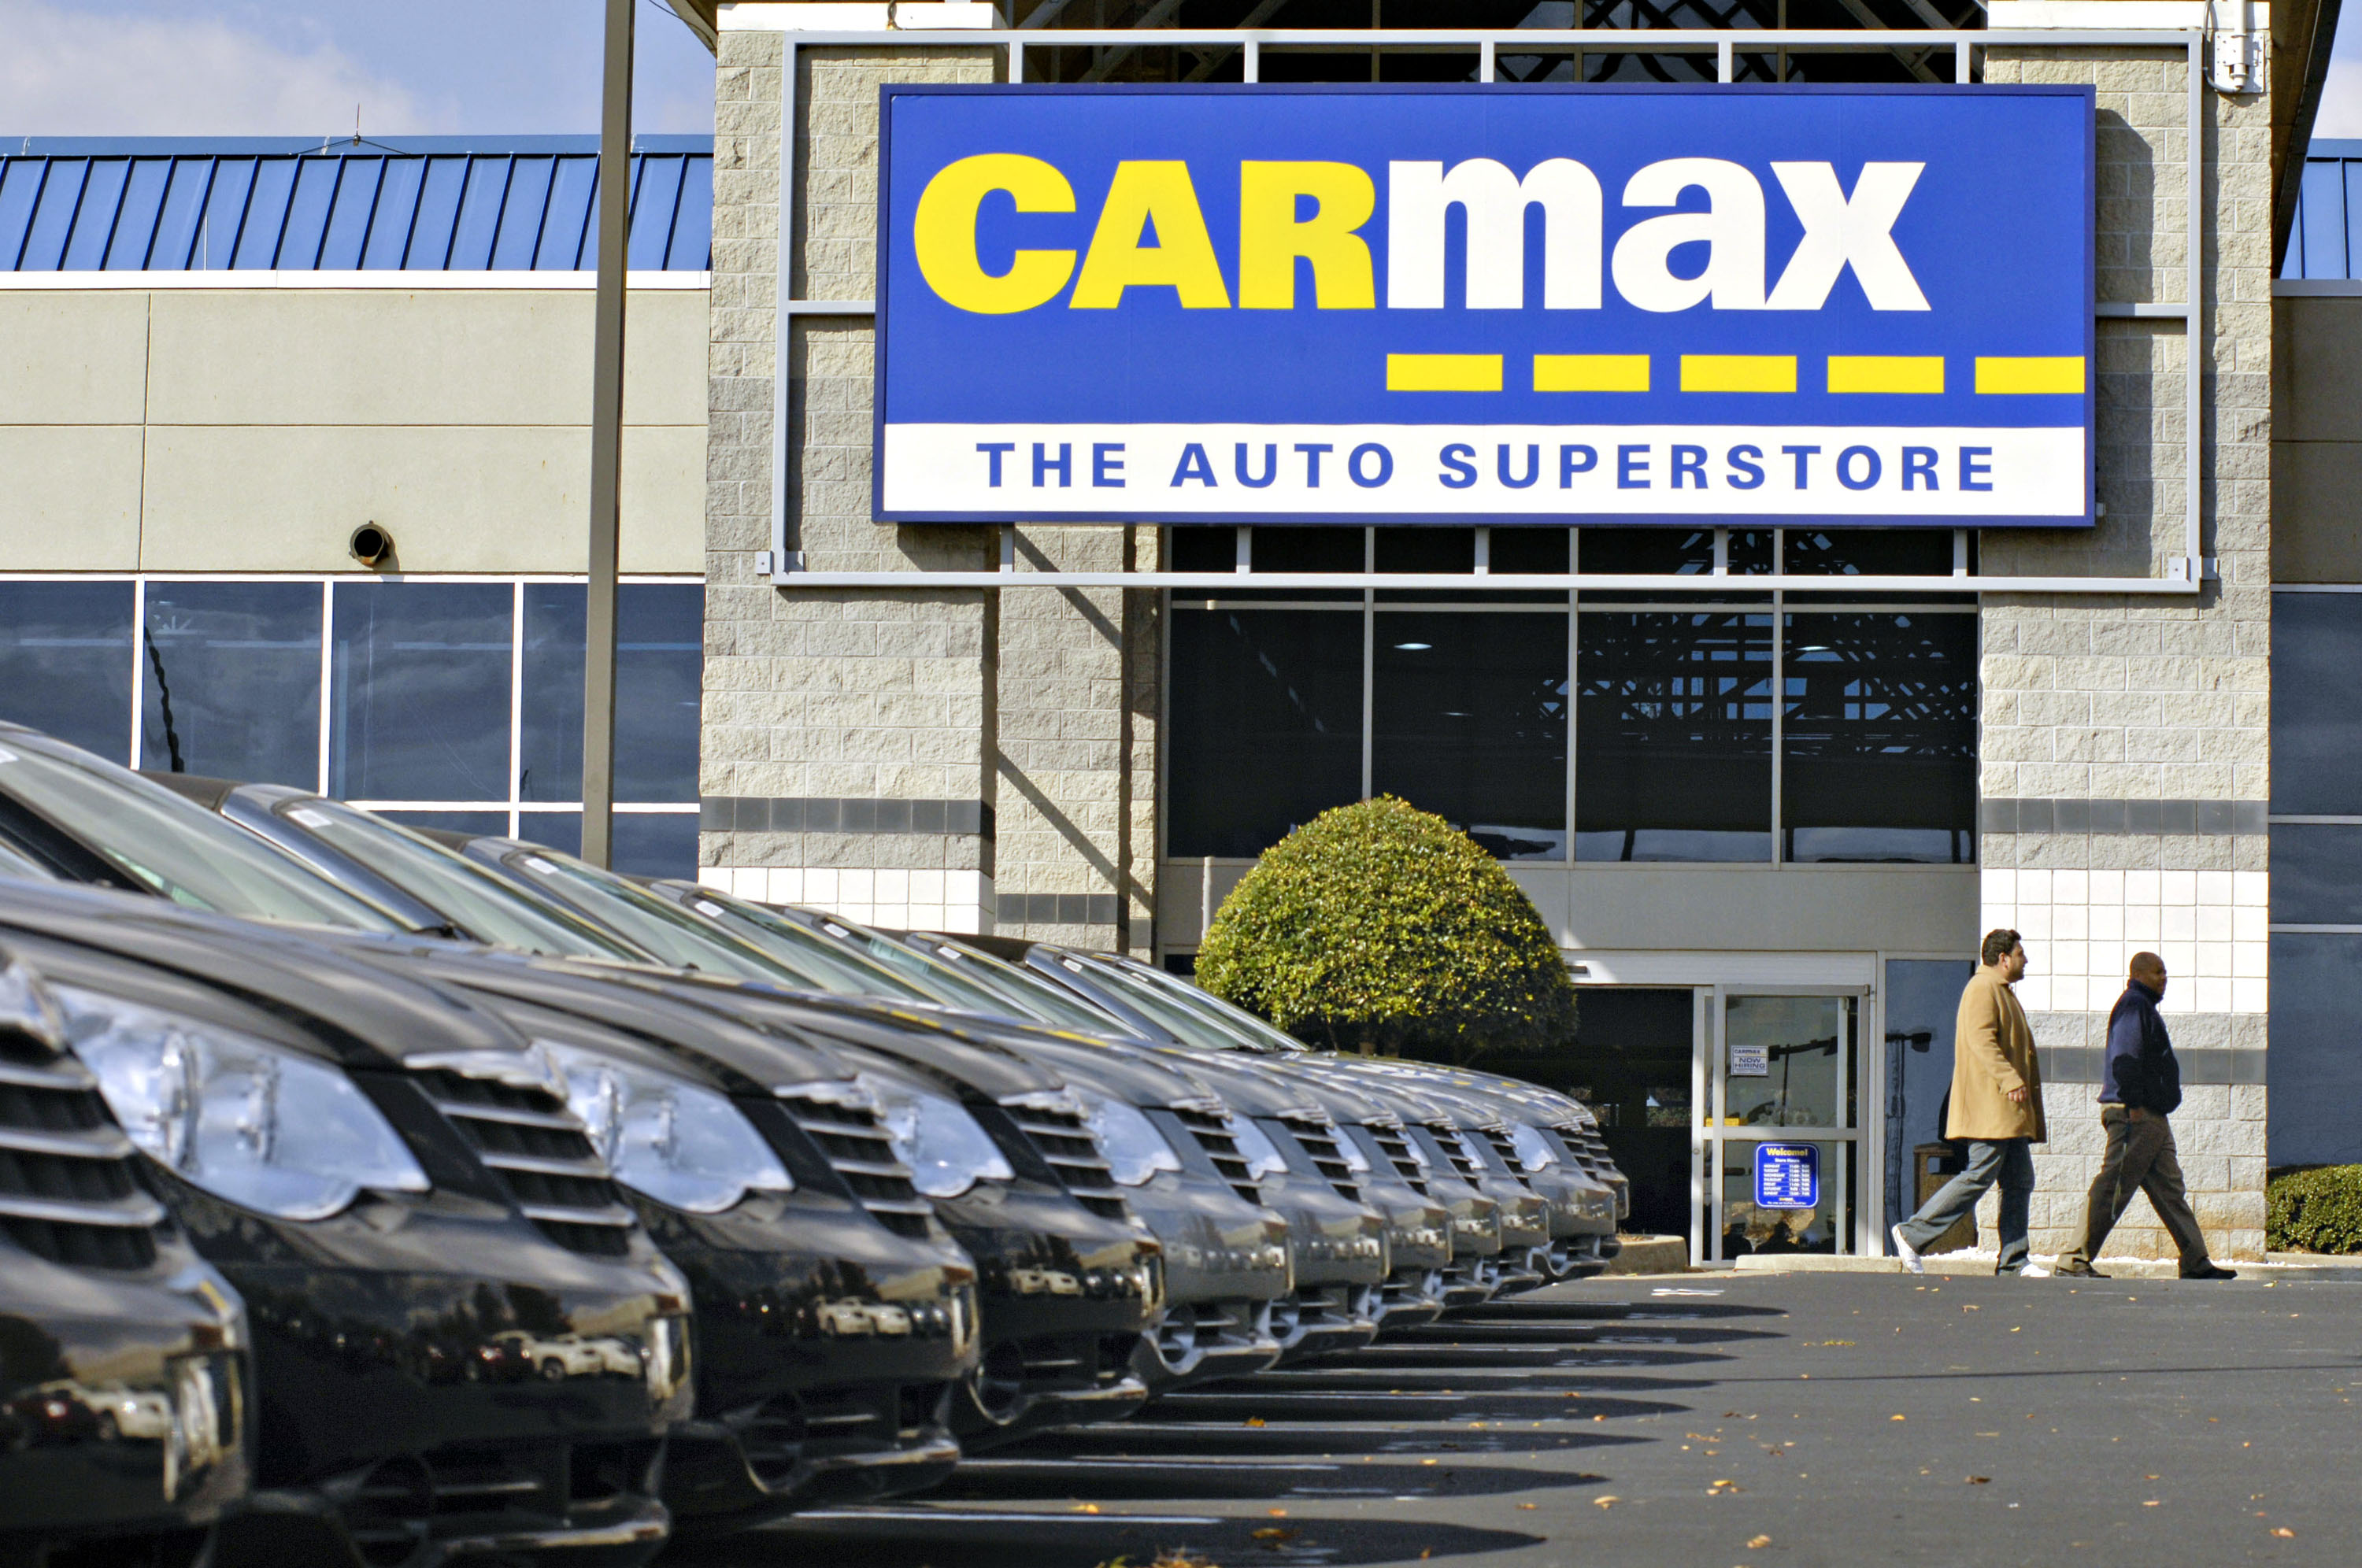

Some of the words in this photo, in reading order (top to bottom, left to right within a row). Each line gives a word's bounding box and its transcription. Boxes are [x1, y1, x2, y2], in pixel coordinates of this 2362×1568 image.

[913, 152, 1932, 315] CARmax
[976, 442, 1126, 487] THE
[1170, 442, 1394, 488] AUTO
[1438, 443, 1993, 491] SUPERSTORE
[1766, 1148, 1809, 1156] Welcome!
